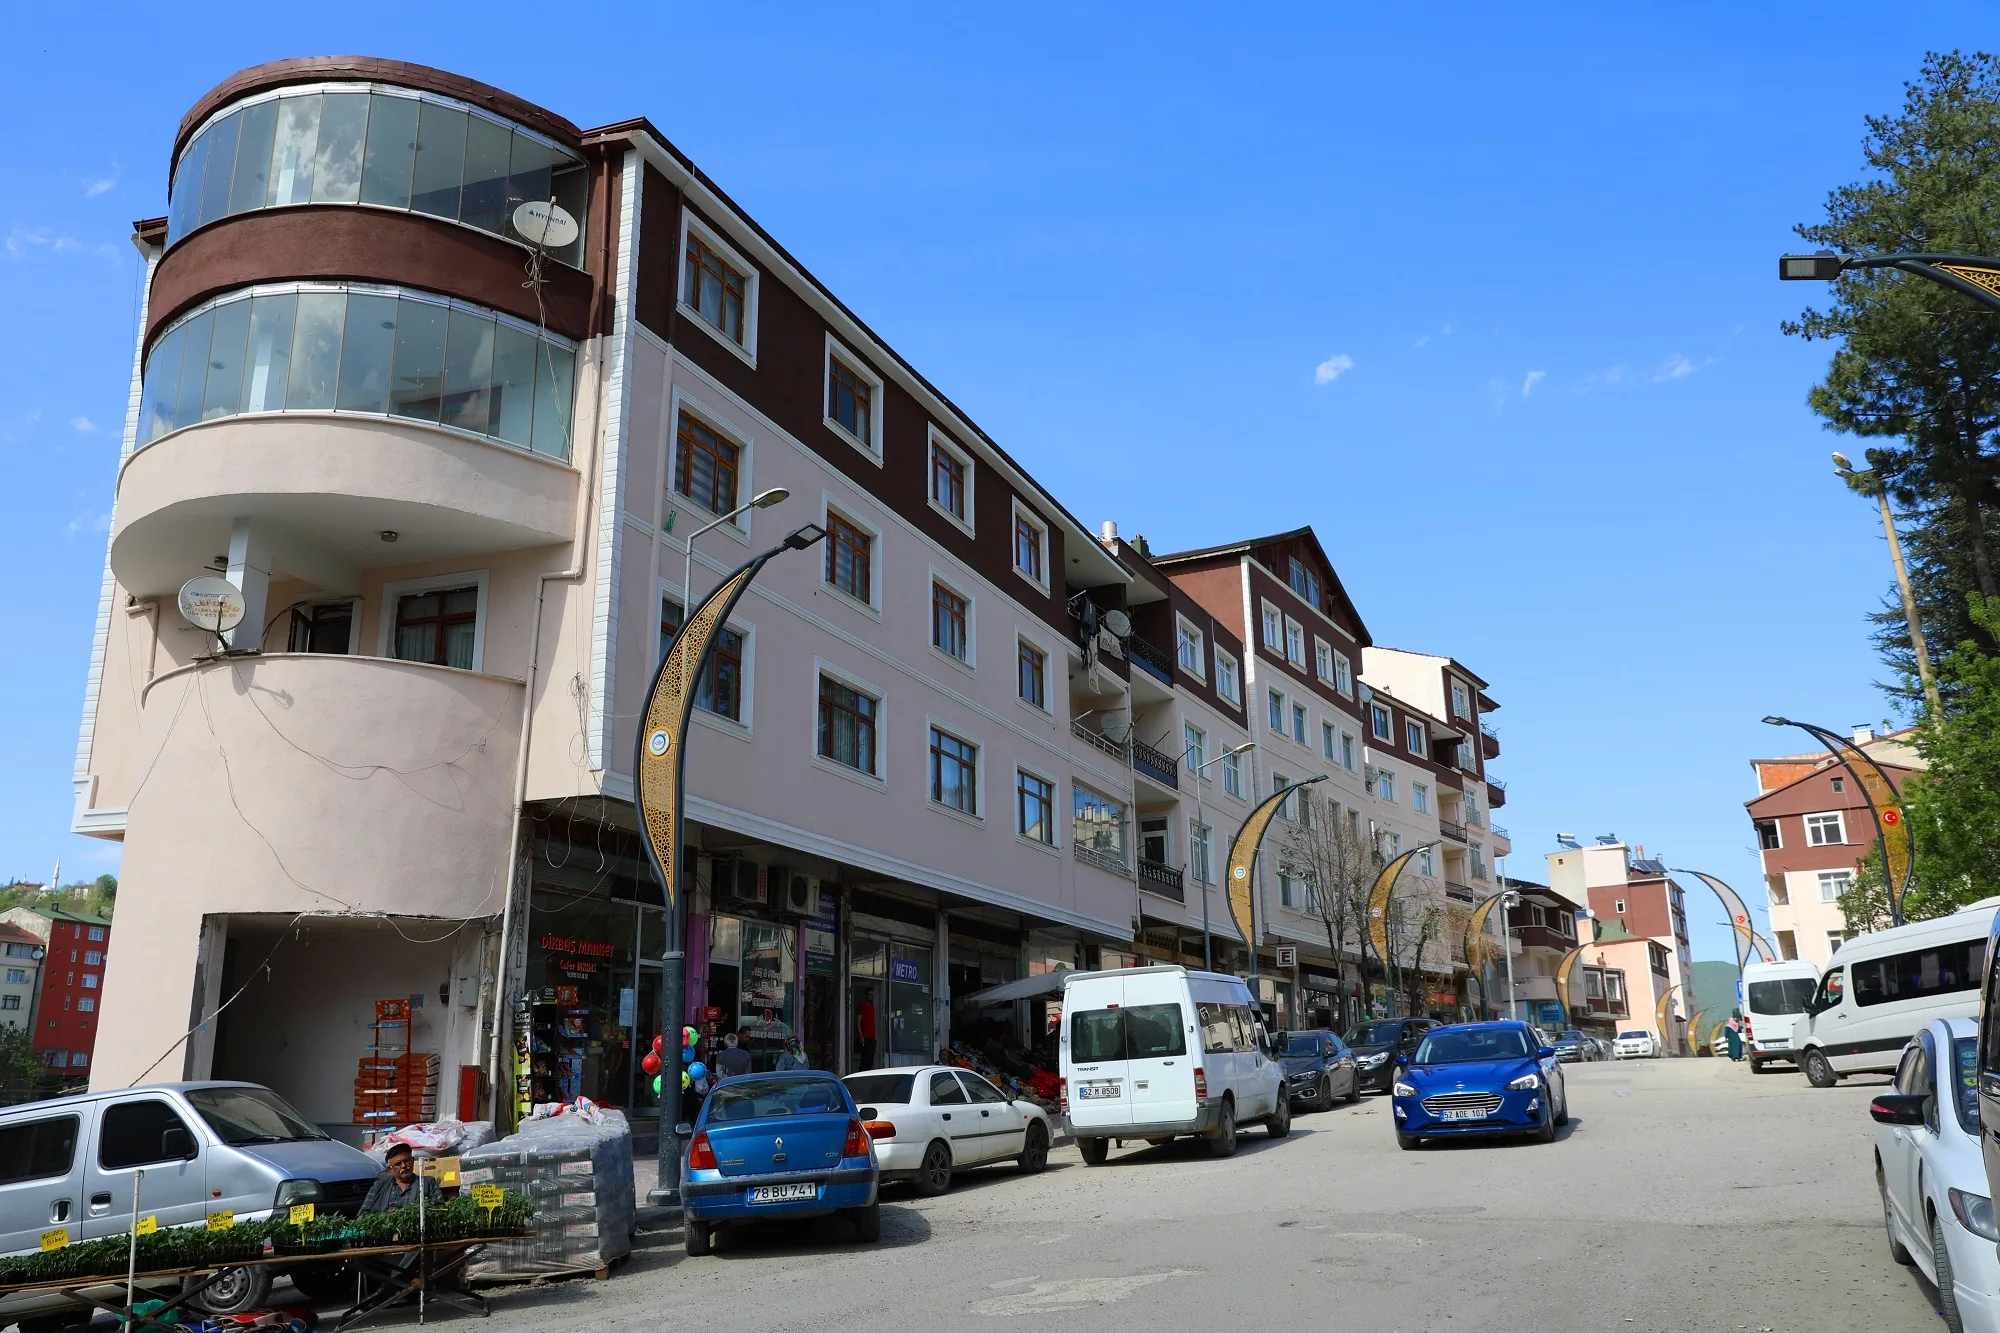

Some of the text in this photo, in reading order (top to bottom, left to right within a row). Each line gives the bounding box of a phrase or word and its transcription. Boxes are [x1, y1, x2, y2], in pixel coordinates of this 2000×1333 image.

[578, 941, 615, 957] MARKET
[1282, 952, 1290, 962] E
[896, 963, 917, 979] METRO
[1102, 1087, 1119, 1095] 8508
[1472, 1109, 1484, 1117] 102
[755, 1184, 813, 1199] 78 BU 741
[46, 1236, 65, 1246] Biber
